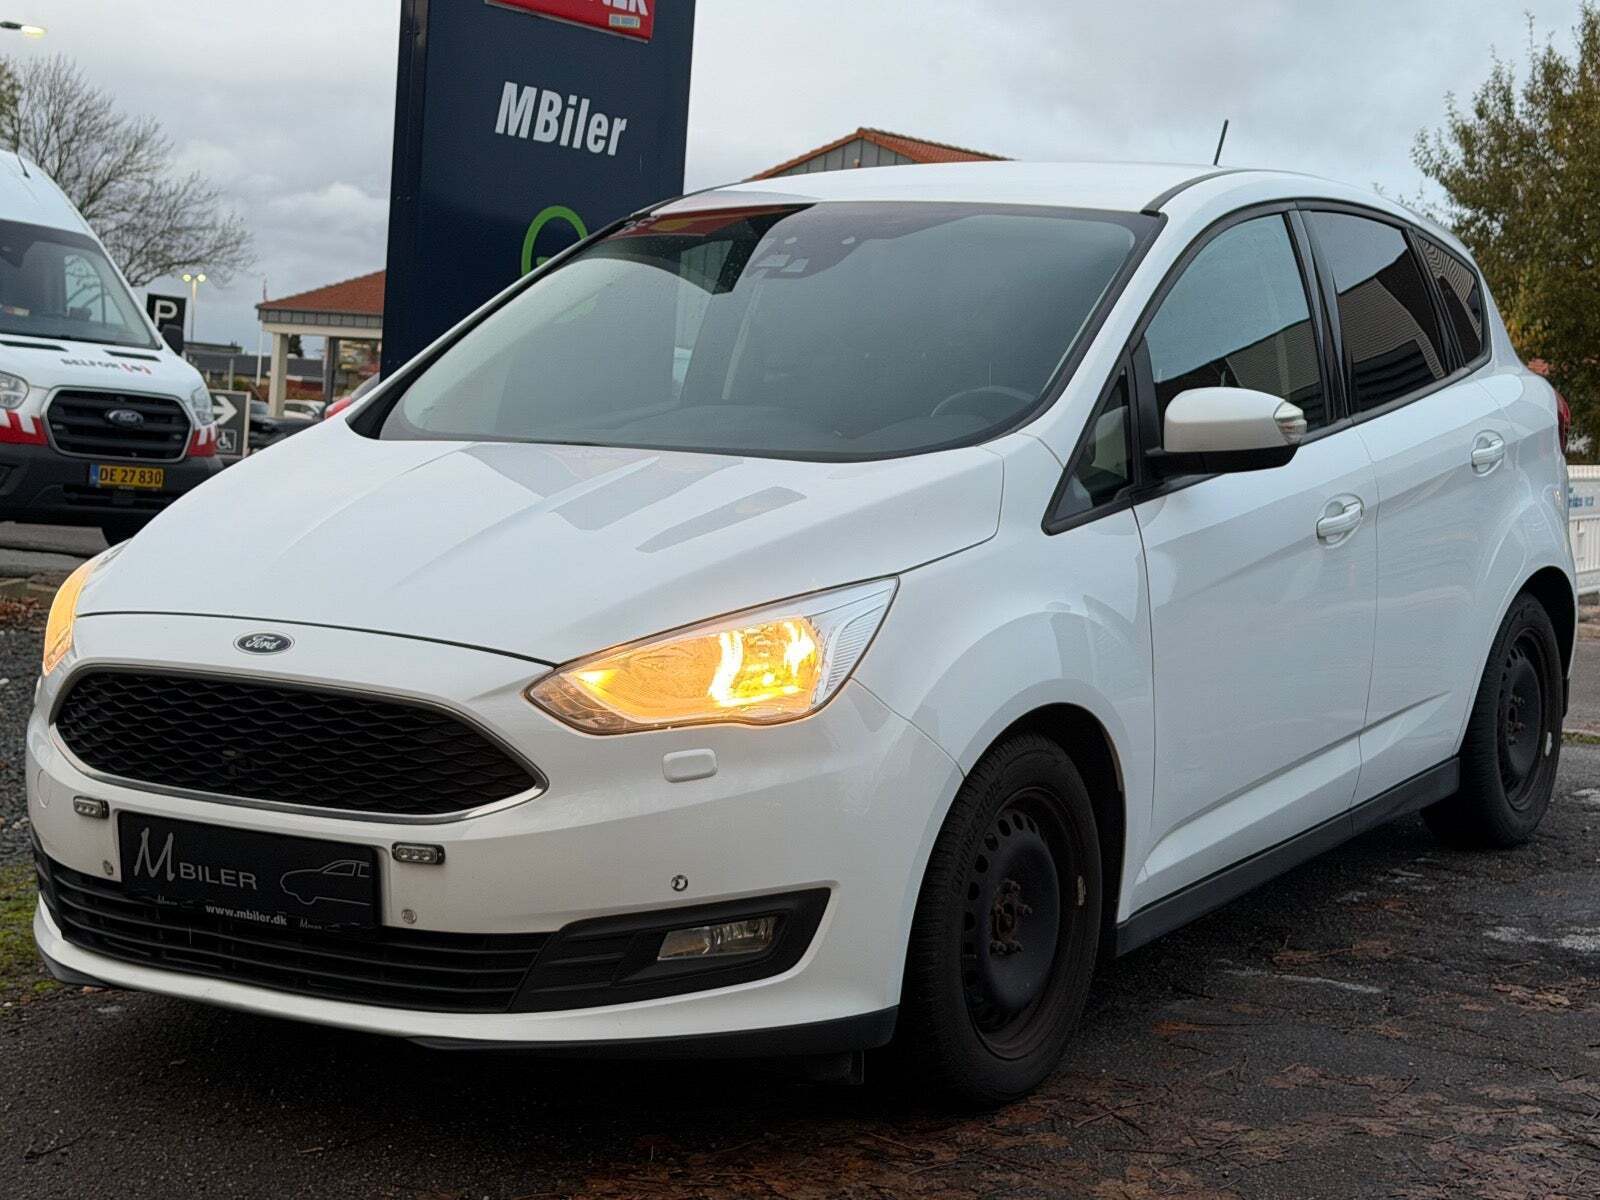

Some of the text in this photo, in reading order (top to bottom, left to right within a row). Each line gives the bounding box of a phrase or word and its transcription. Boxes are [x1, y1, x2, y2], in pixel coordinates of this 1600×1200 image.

[495, 81, 628, 156] MBiler
[154, 299, 178, 328] P
[101, 467, 162, 485] DE 27 830
[245, 634, 281, 650] Ford
